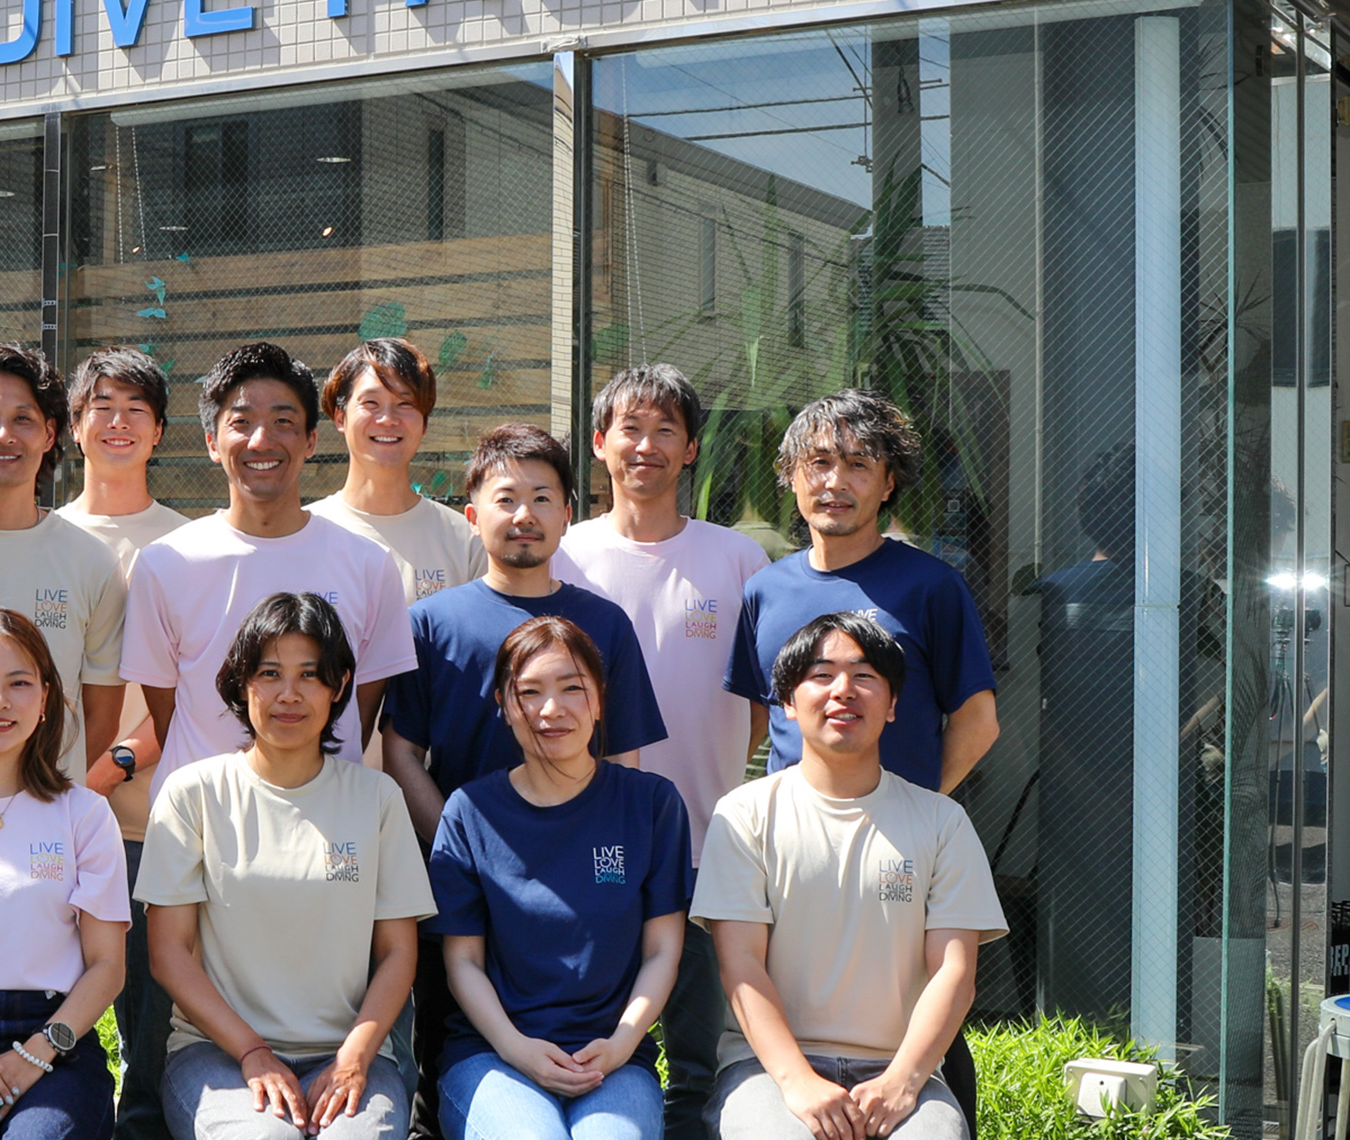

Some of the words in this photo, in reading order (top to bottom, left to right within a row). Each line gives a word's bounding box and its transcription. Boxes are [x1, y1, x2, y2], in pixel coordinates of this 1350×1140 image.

[415, 569, 445, 581] LIVE
[415, 580, 446, 590] LOVE
[35, 589, 68, 603] LIVE
[35, 600, 67, 613] LOVE
[685, 599, 718, 613] LIVE
[35, 611, 67, 620] LAUGH
[685, 610, 718, 623] LOVE
[851, 608, 879, 621] IVE
[34, 619, 67, 629] DIVING
[685, 621, 717, 630] LAUGH
[685, 629, 717, 639] DIVING
[30, 841, 64, 855] LIVE
[323, 842, 357, 855] LIVE
[593, 845, 624, 859] LIVE
[30, 853, 64, 865] LOVE
[324, 854, 358, 865] LOVE
[594, 857, 624, 869] LOVE
[30, 863, 64, 872] LAUGH
[325, 864, 359, 872] LAUGH
[595, 867, 625, 876] LAUGH
[879, 860, 913, 874] LIVE
[30, 870, 64, 881] DIVING
[326, 872, 360, 882] DIVING
[595, 875, 626, 884] DIVING
[879, 871, 913, 885] LOVE
[879, 884, 913, 893] LAUGH
[879, 892, 912, 903] DIVING
